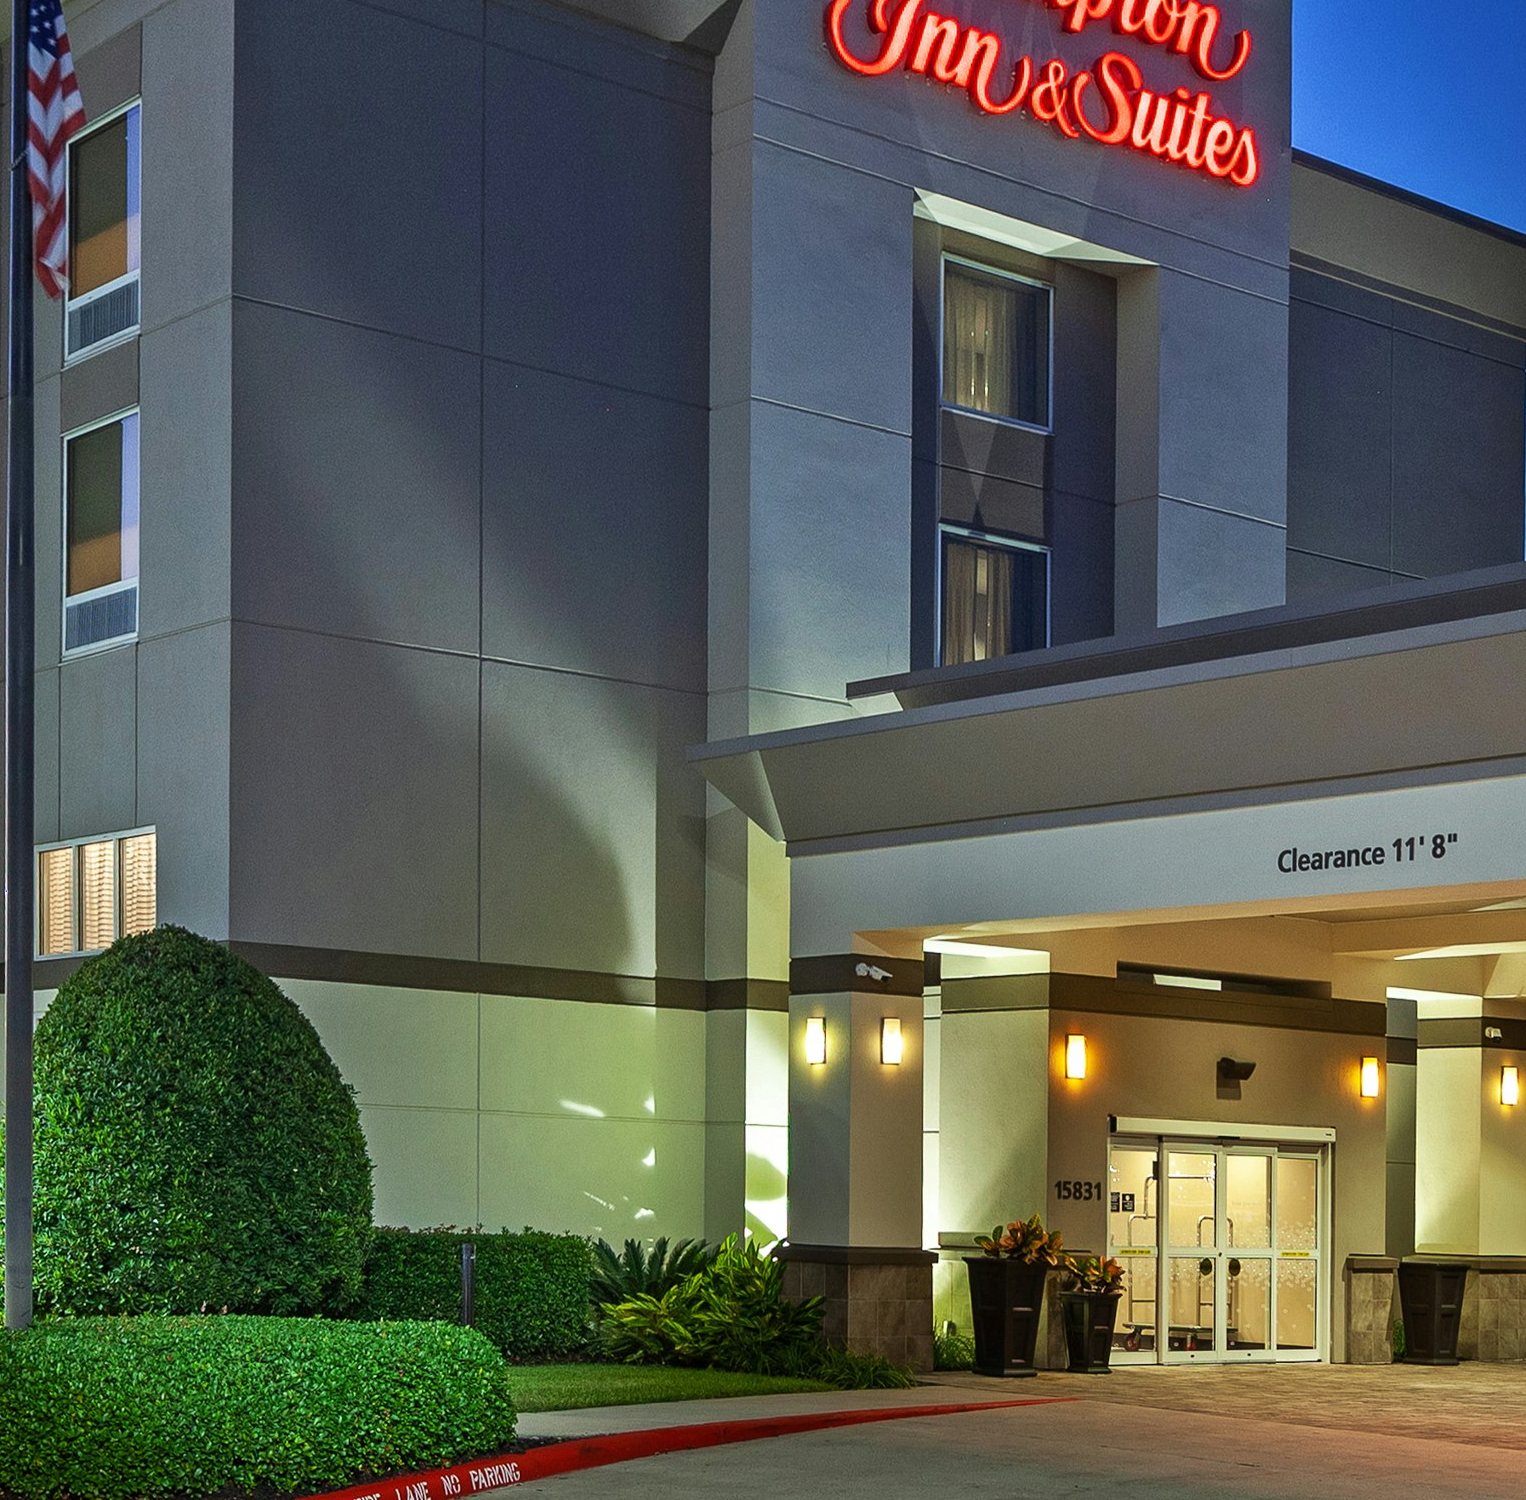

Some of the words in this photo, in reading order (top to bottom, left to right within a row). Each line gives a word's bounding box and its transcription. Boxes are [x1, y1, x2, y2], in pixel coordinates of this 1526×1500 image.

[1030, 59, 1079, 138] &
[1072, 52, 1260, 187] Suites
[1277, 847, 1385, 873] Clearance
[1392, 835, 1424, 862] 11'
[1431, 833, 1458, 858] 8"
[1054, 1180, 1102, 1200] 15831
[441, 1474, 461, 1496] NO
[469, 1462, 520, 1491] PARKING
